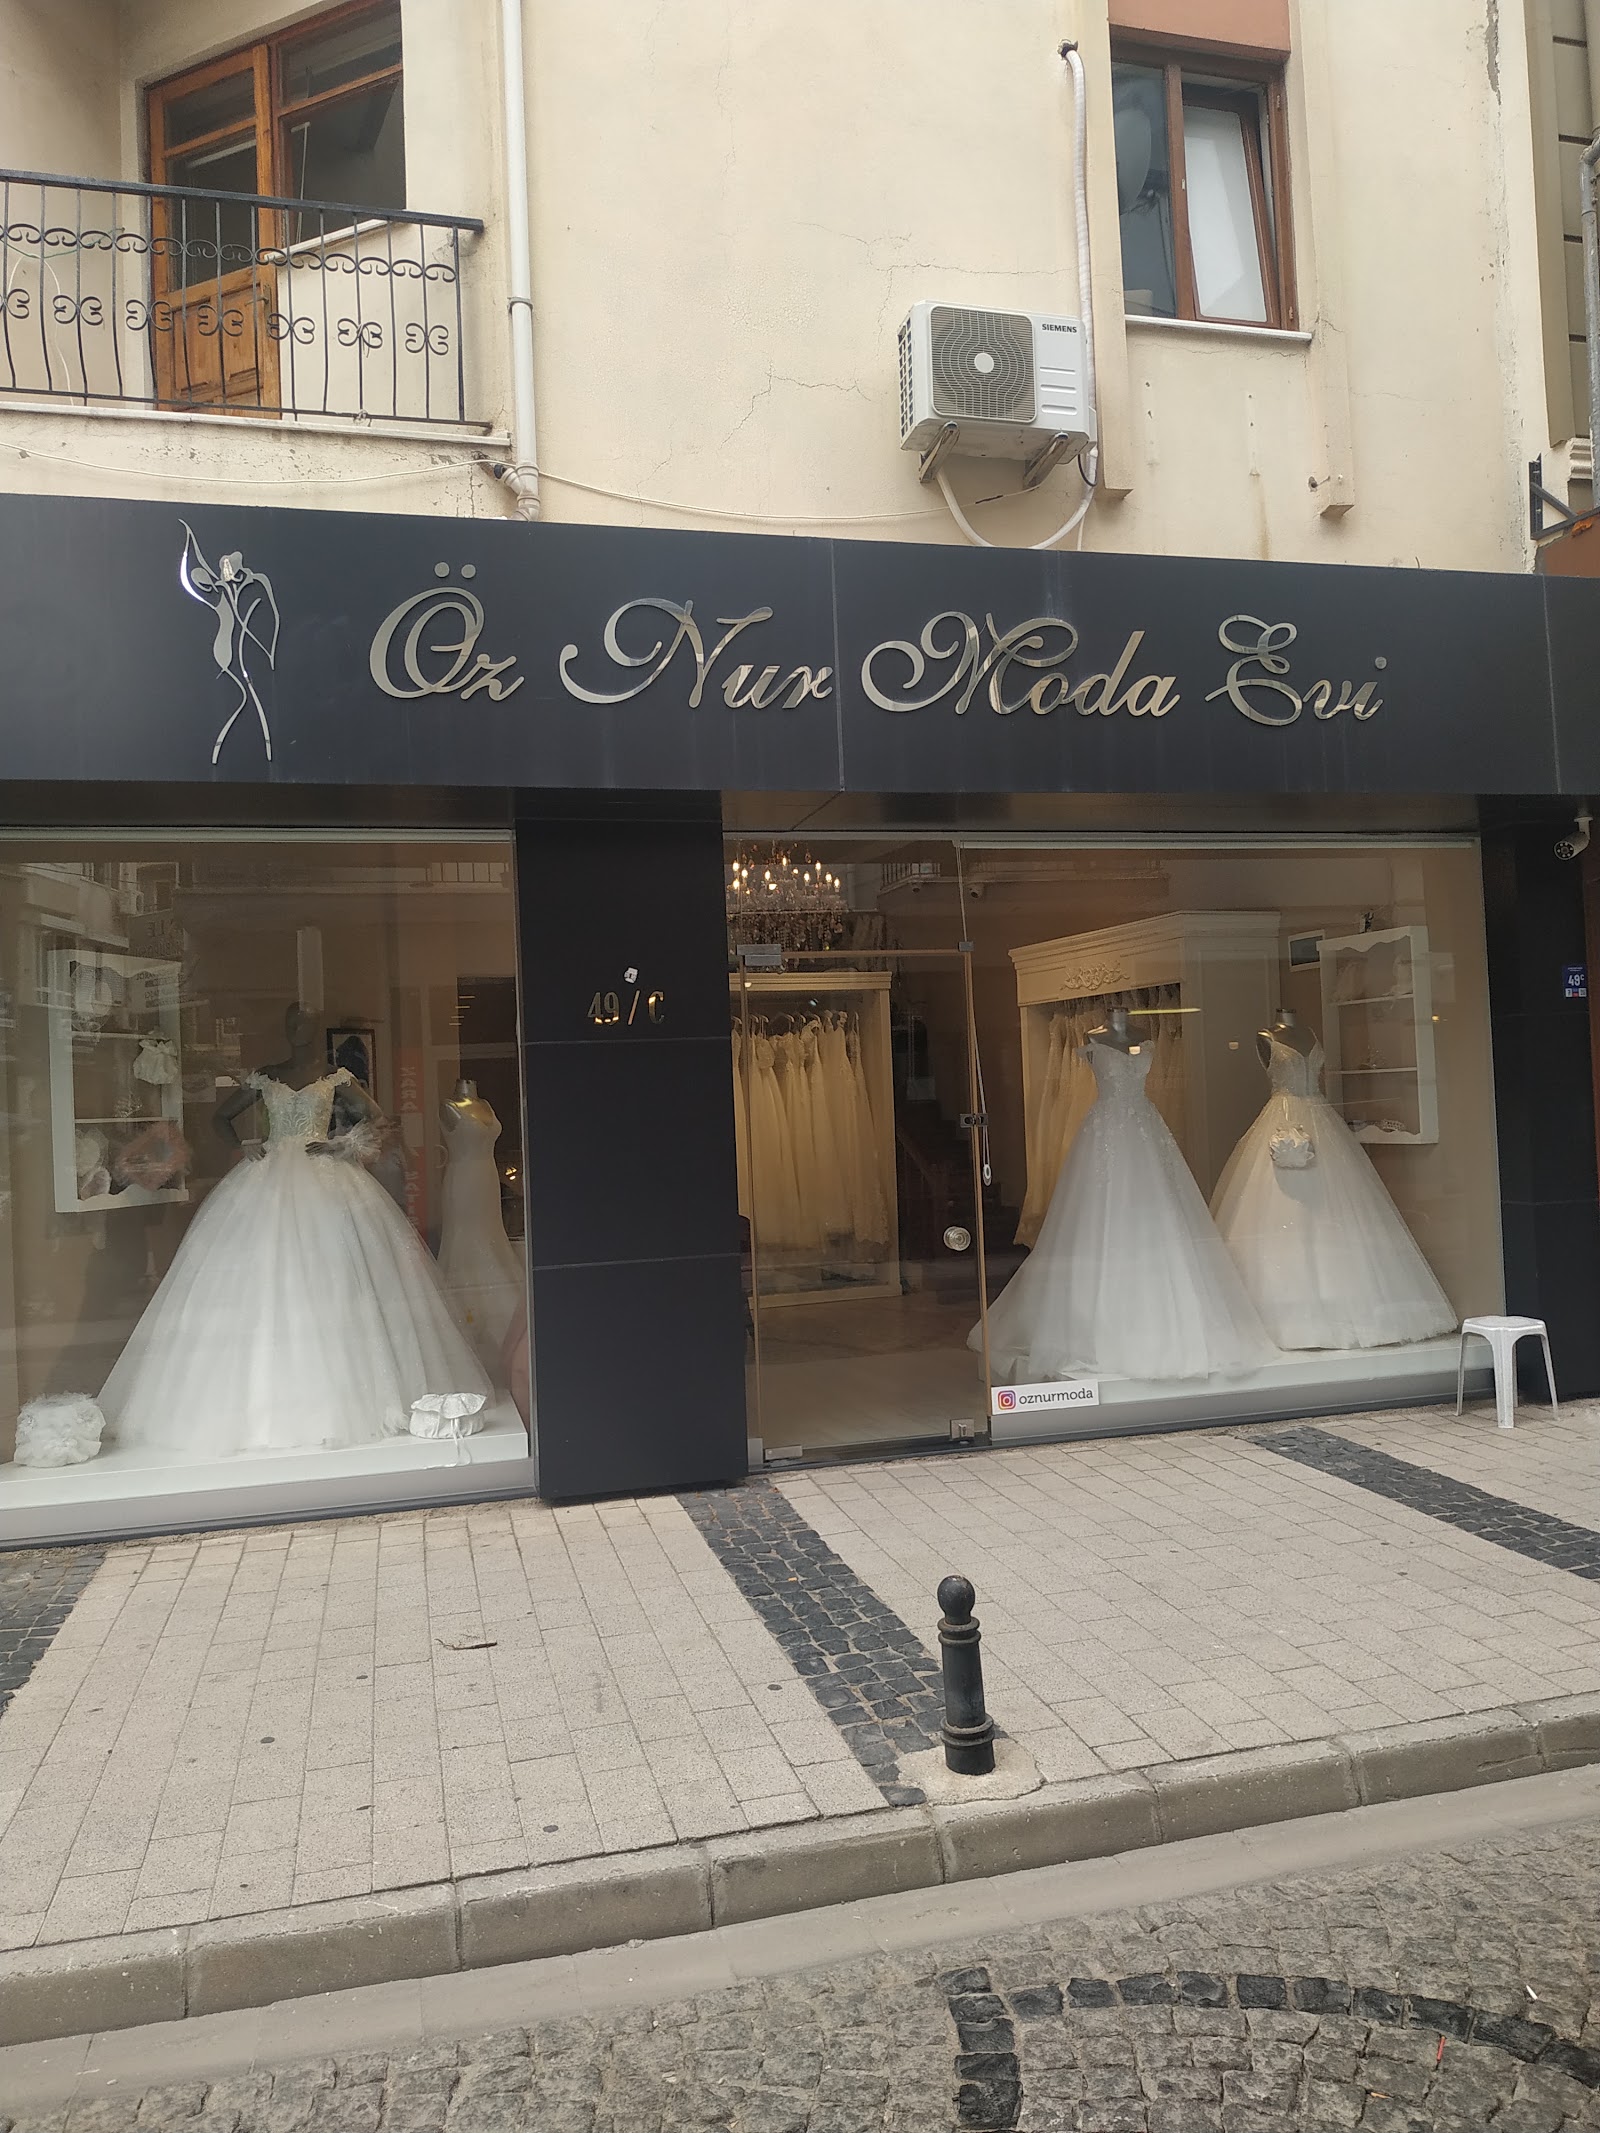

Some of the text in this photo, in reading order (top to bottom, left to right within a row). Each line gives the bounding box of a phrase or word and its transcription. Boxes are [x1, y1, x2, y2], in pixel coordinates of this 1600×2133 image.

[1041, 322, 1077, 334] SIEMENS
[368, 560, 1388, 727] Öz Nur Moda Evi
[1018, 1387, 1094, 1405] oznurmoda
